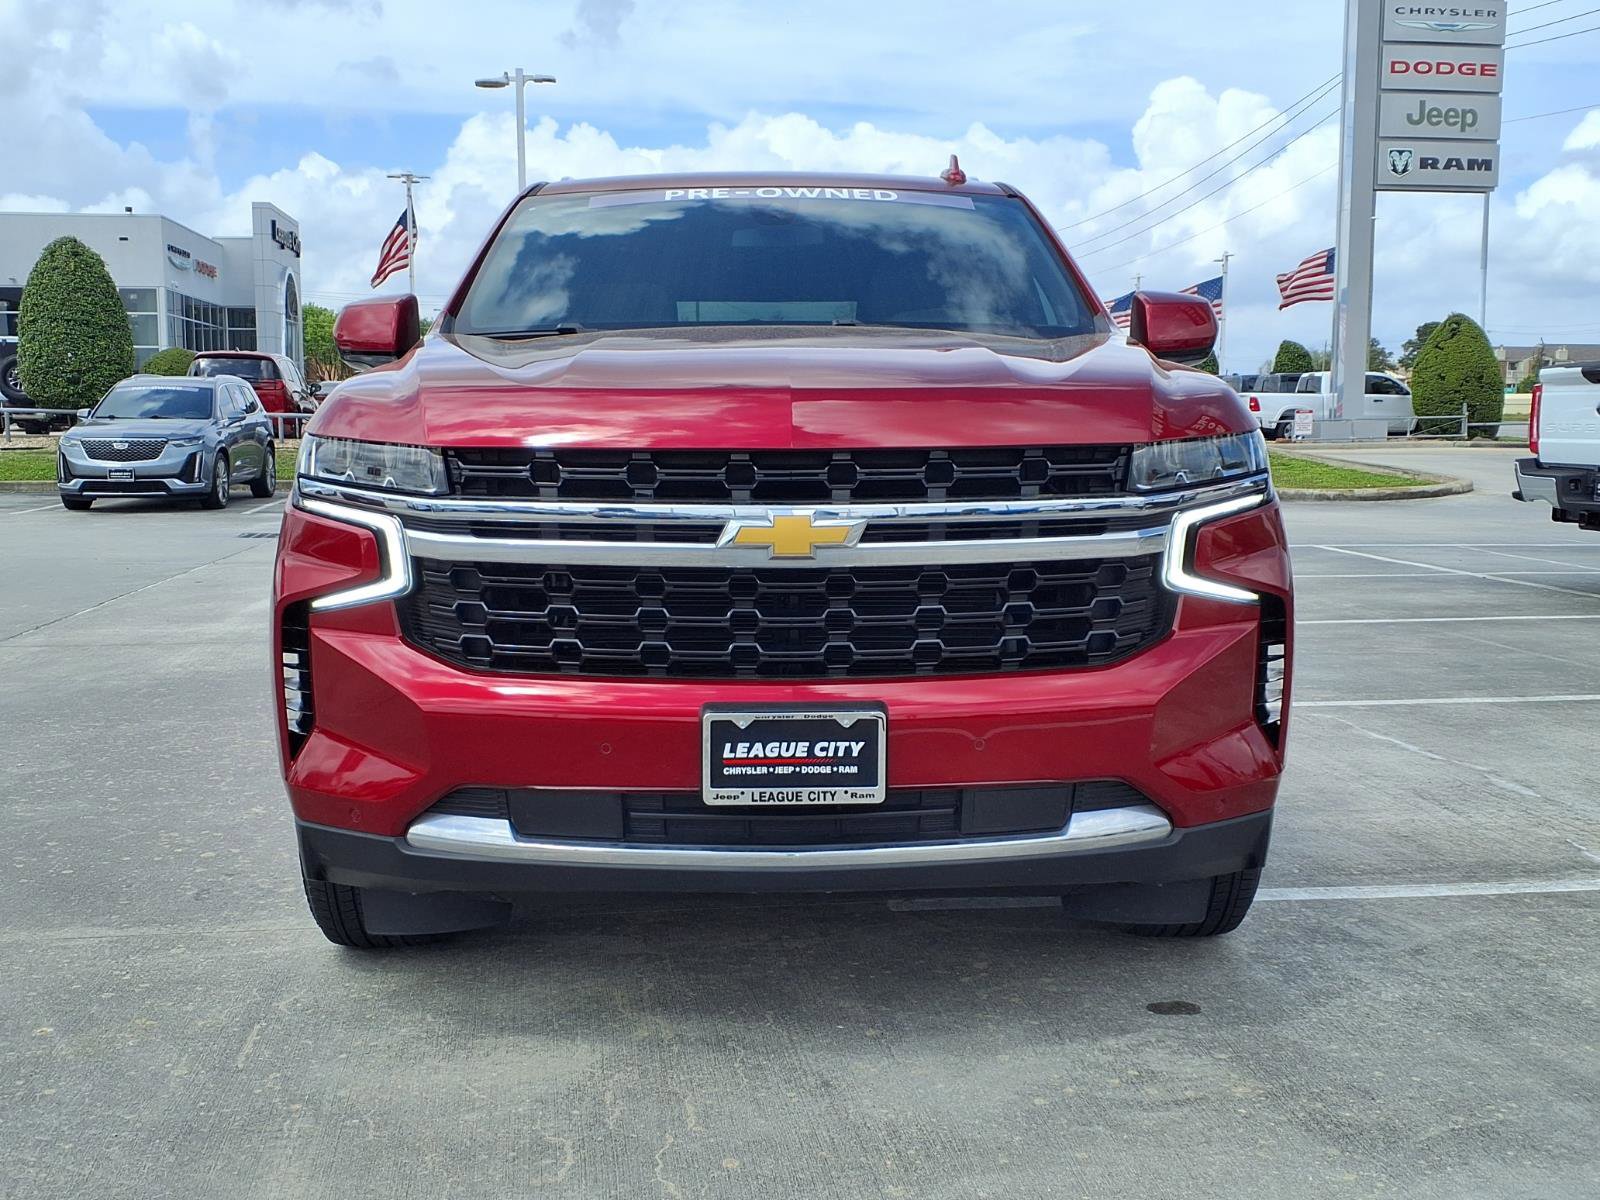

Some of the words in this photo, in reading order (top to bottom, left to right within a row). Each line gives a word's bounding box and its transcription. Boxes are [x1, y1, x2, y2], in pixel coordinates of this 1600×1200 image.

[1395, 7, 1497, 18] CHRYSLER
[1390, 60, 1498, 77] DODGE
[1406, 100, 1478, 133] Jeep
[1419, 156, 1493, 172] RAM
[664, 187, 899, 201] PRE-OWNED
[722, 741, 810, 759] LEAGUE
[814, 741, 866, 758] CITY
[723, 766, 768, 775] CHRYSLER
[774, 766, 795, 775] JEEP
[801, 766, 832, 774] DODGE
[838, 765, 858, 774] RAM
[712, 792, 740, 801] Jeep
[751, 791, 804, 803] LEAGUE
[807, 790, 838, 802] CITY
[850, 791, 876, 799] Ram
